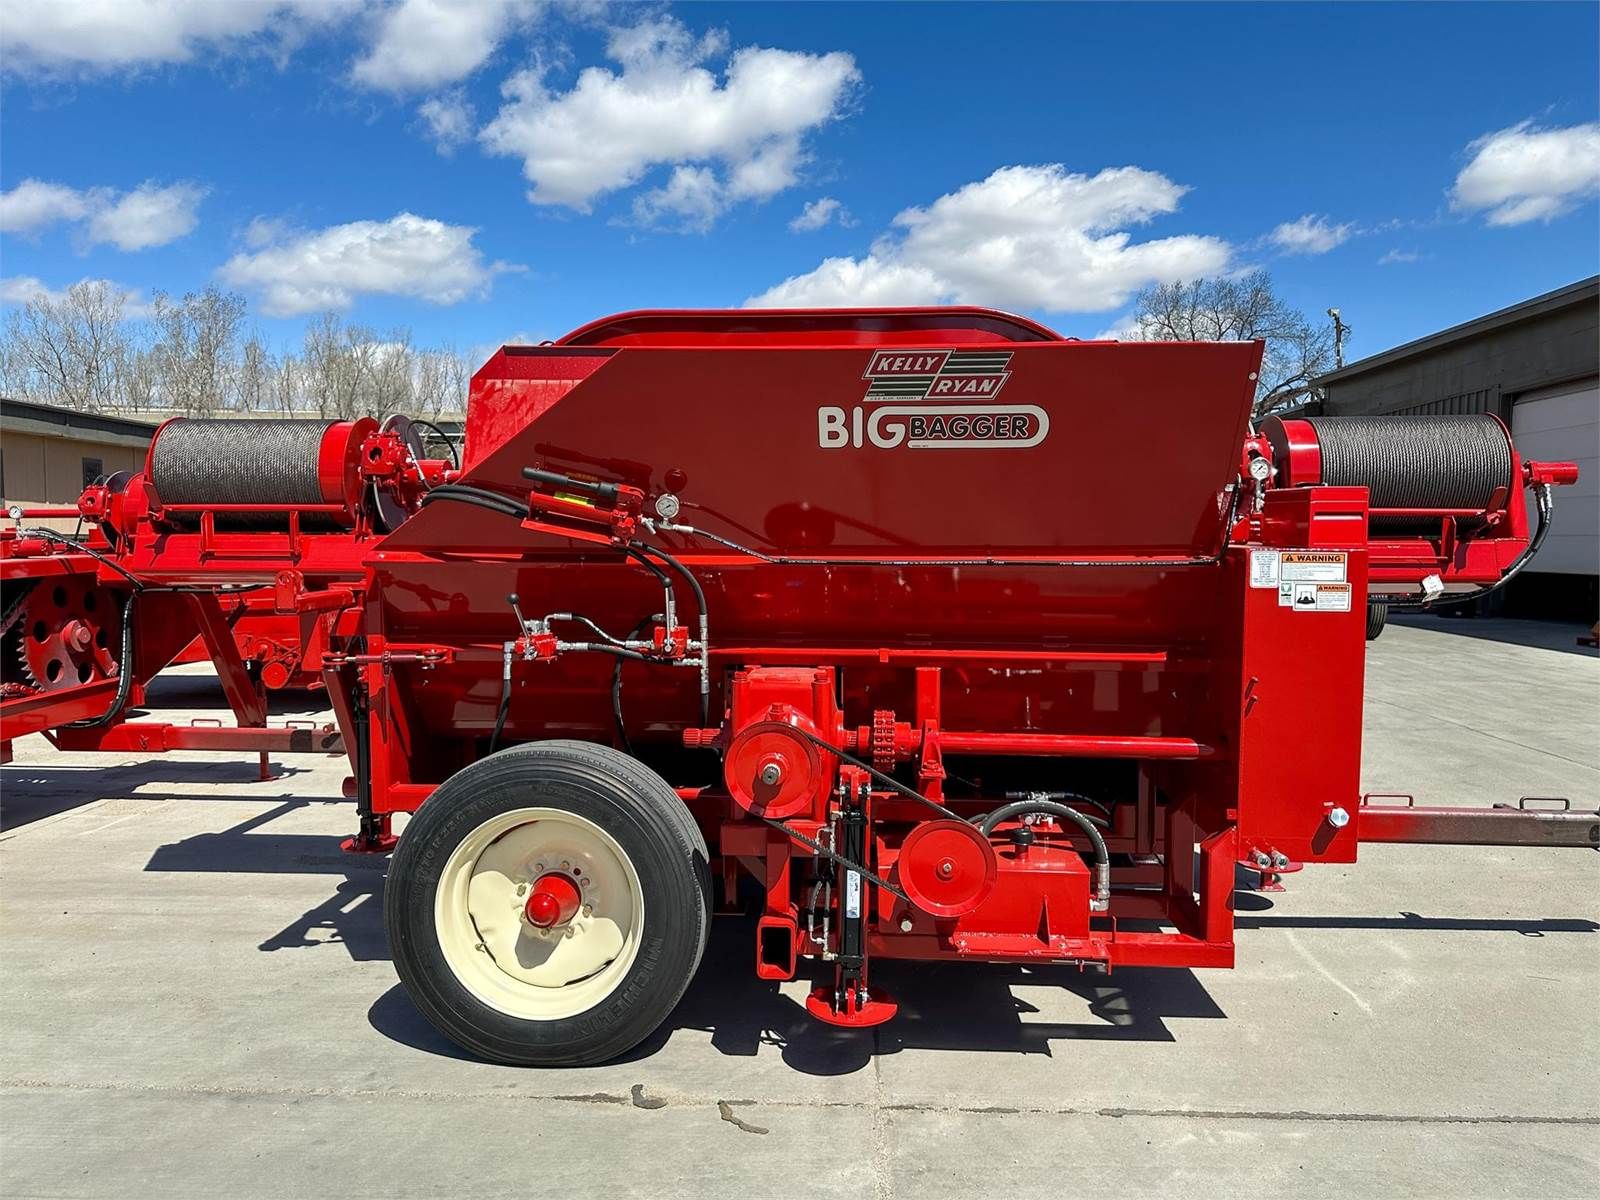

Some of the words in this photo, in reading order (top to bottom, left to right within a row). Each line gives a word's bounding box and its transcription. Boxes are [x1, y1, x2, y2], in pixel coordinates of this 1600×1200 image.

[876, 355, 940, 371] KELLY
[934, 379, 996, 393] RYAN
[818, 405, 906, 448] BIG
[910, 416, 1029, 439] BAGGER
